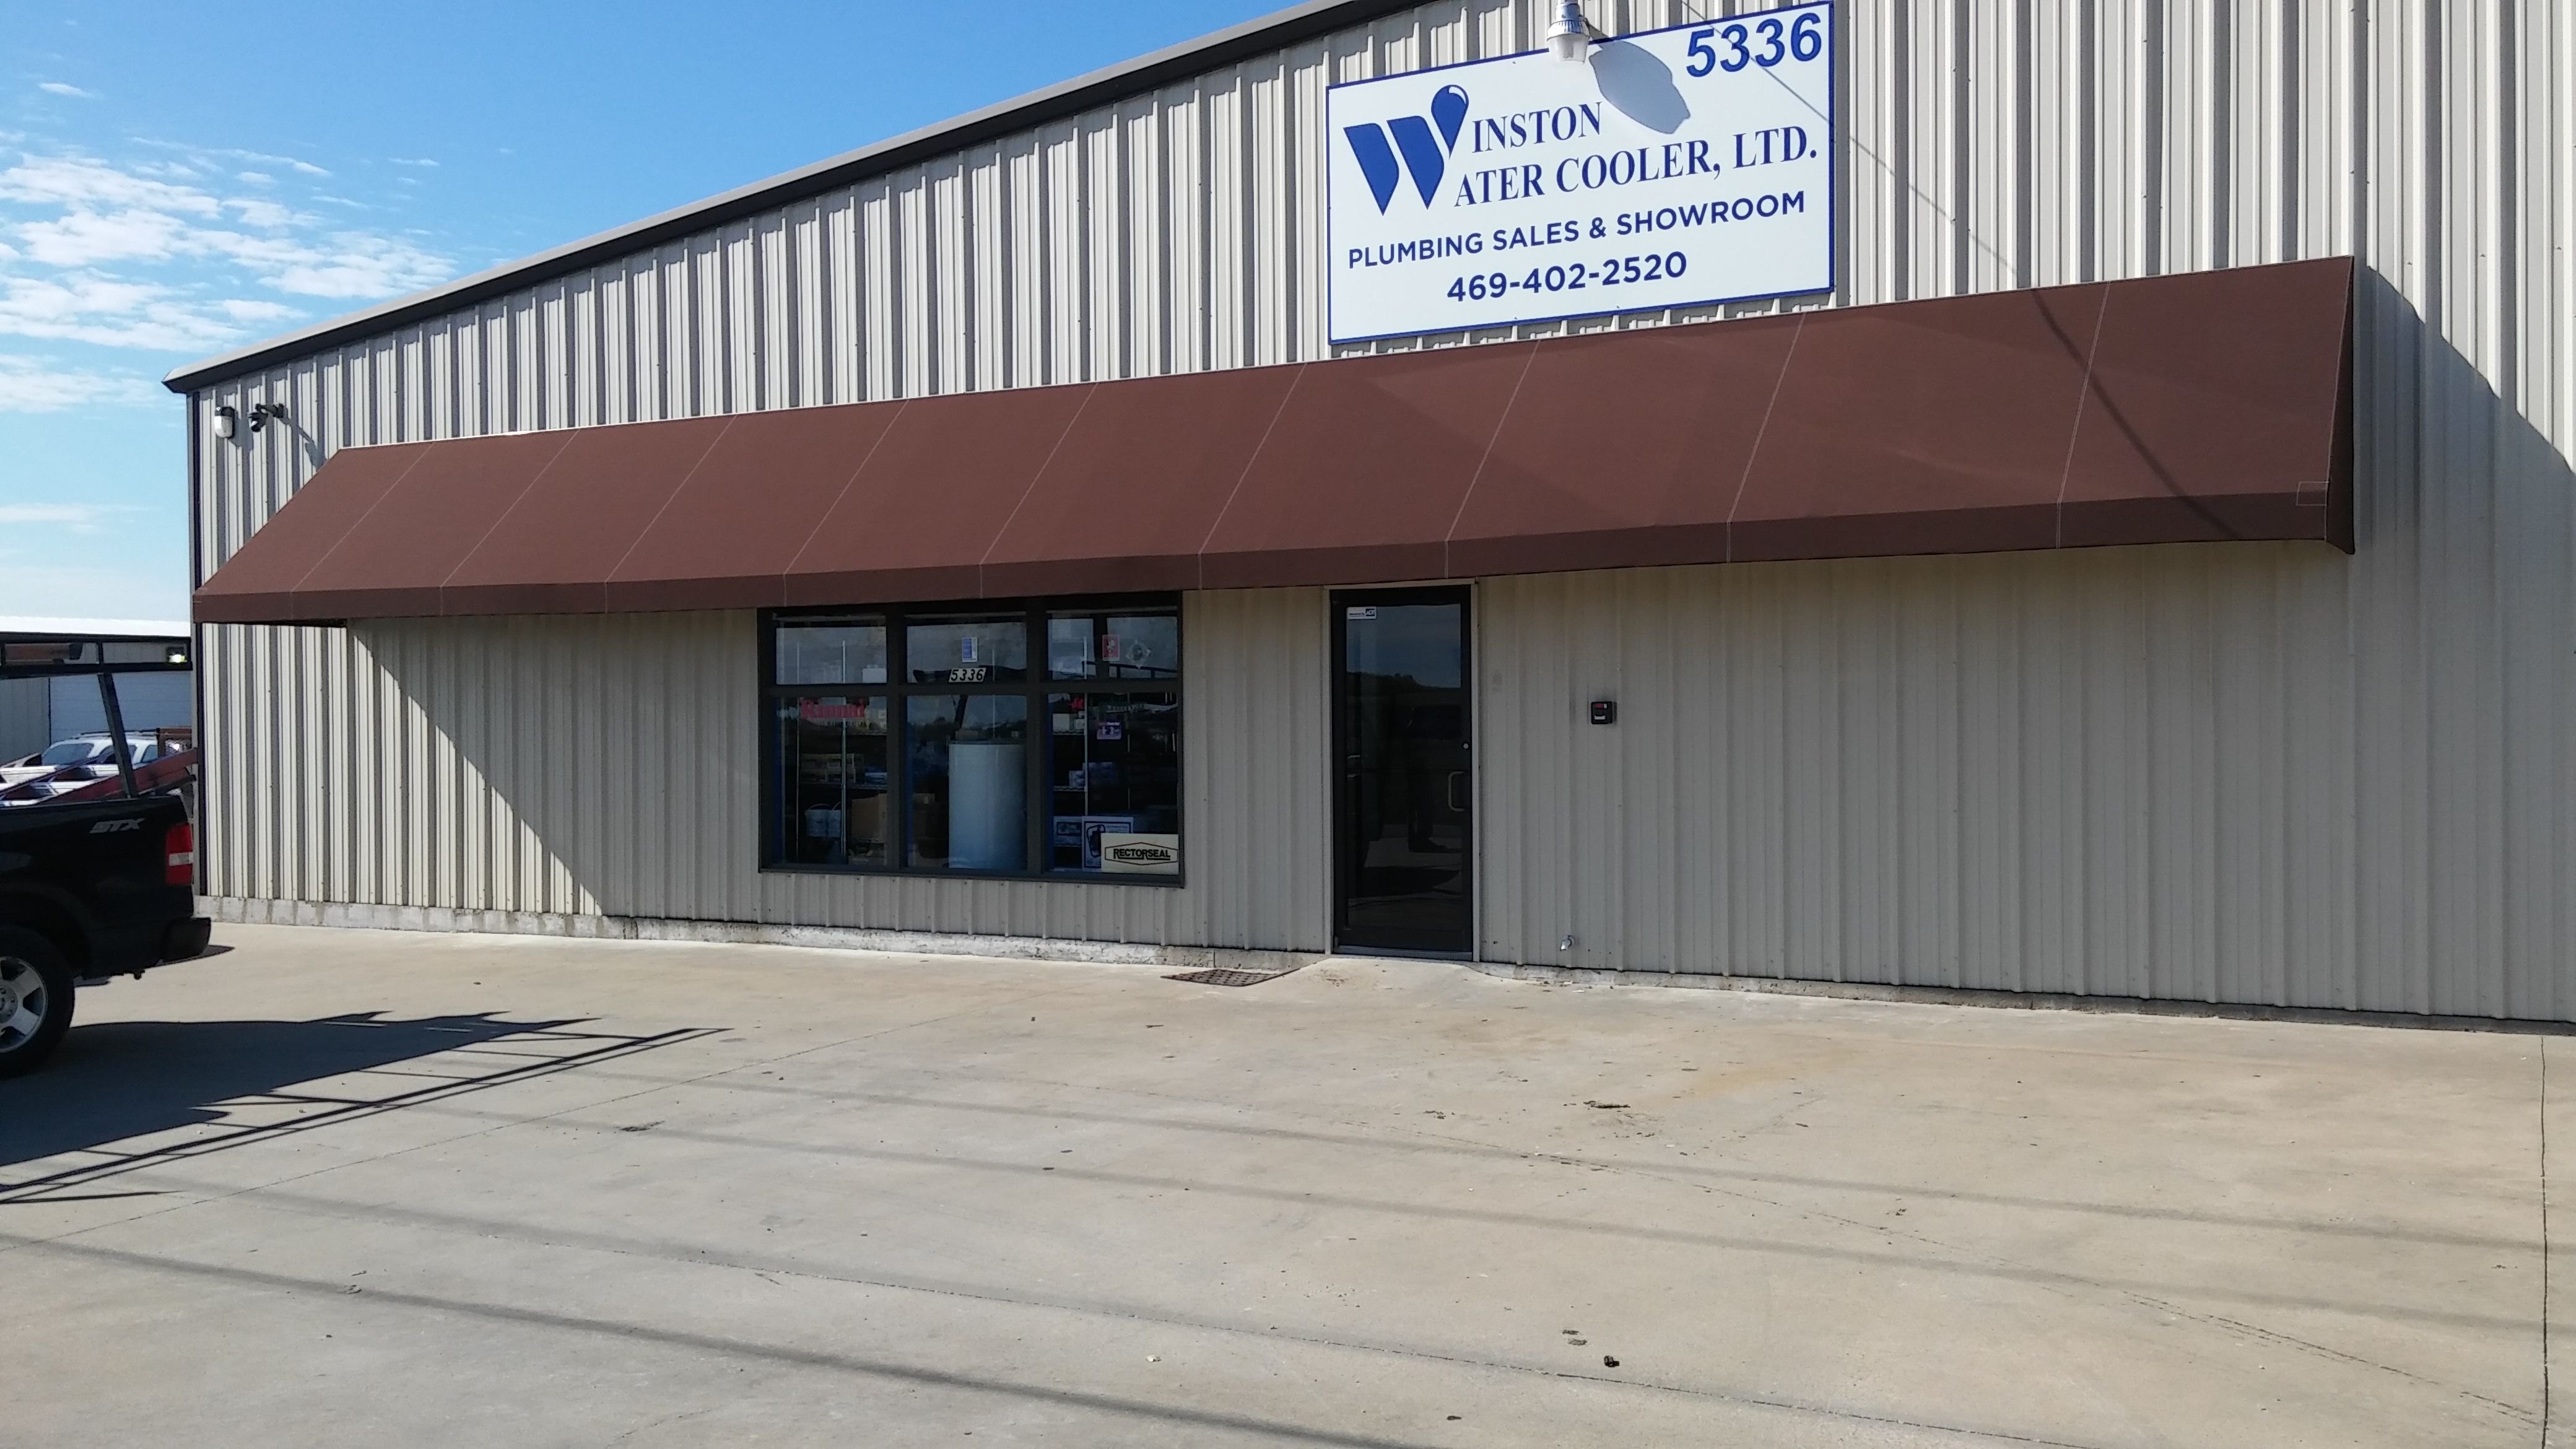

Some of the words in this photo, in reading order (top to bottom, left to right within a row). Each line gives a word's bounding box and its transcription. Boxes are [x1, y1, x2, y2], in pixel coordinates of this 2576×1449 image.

[1686, 12, 1822, 77] 5336
[1556, 140, 1720, 193] COOLER,
[1733, 126, 1817, 169] LTD.
[1349, 232, 1483, 269] PLUMBING
[1493, 220, 1579, 251] SALES
[1589, 217, 1606, 238] &
[1617, 191, 1805, 235] SHOWROOM
[1447, 251, 1687, 302] 469-402-2520
[951, 669, 984, 681] 5336
[89, 818, 146, 834] STX
[1113, 848, 1171, 861] RECTORSEAL
